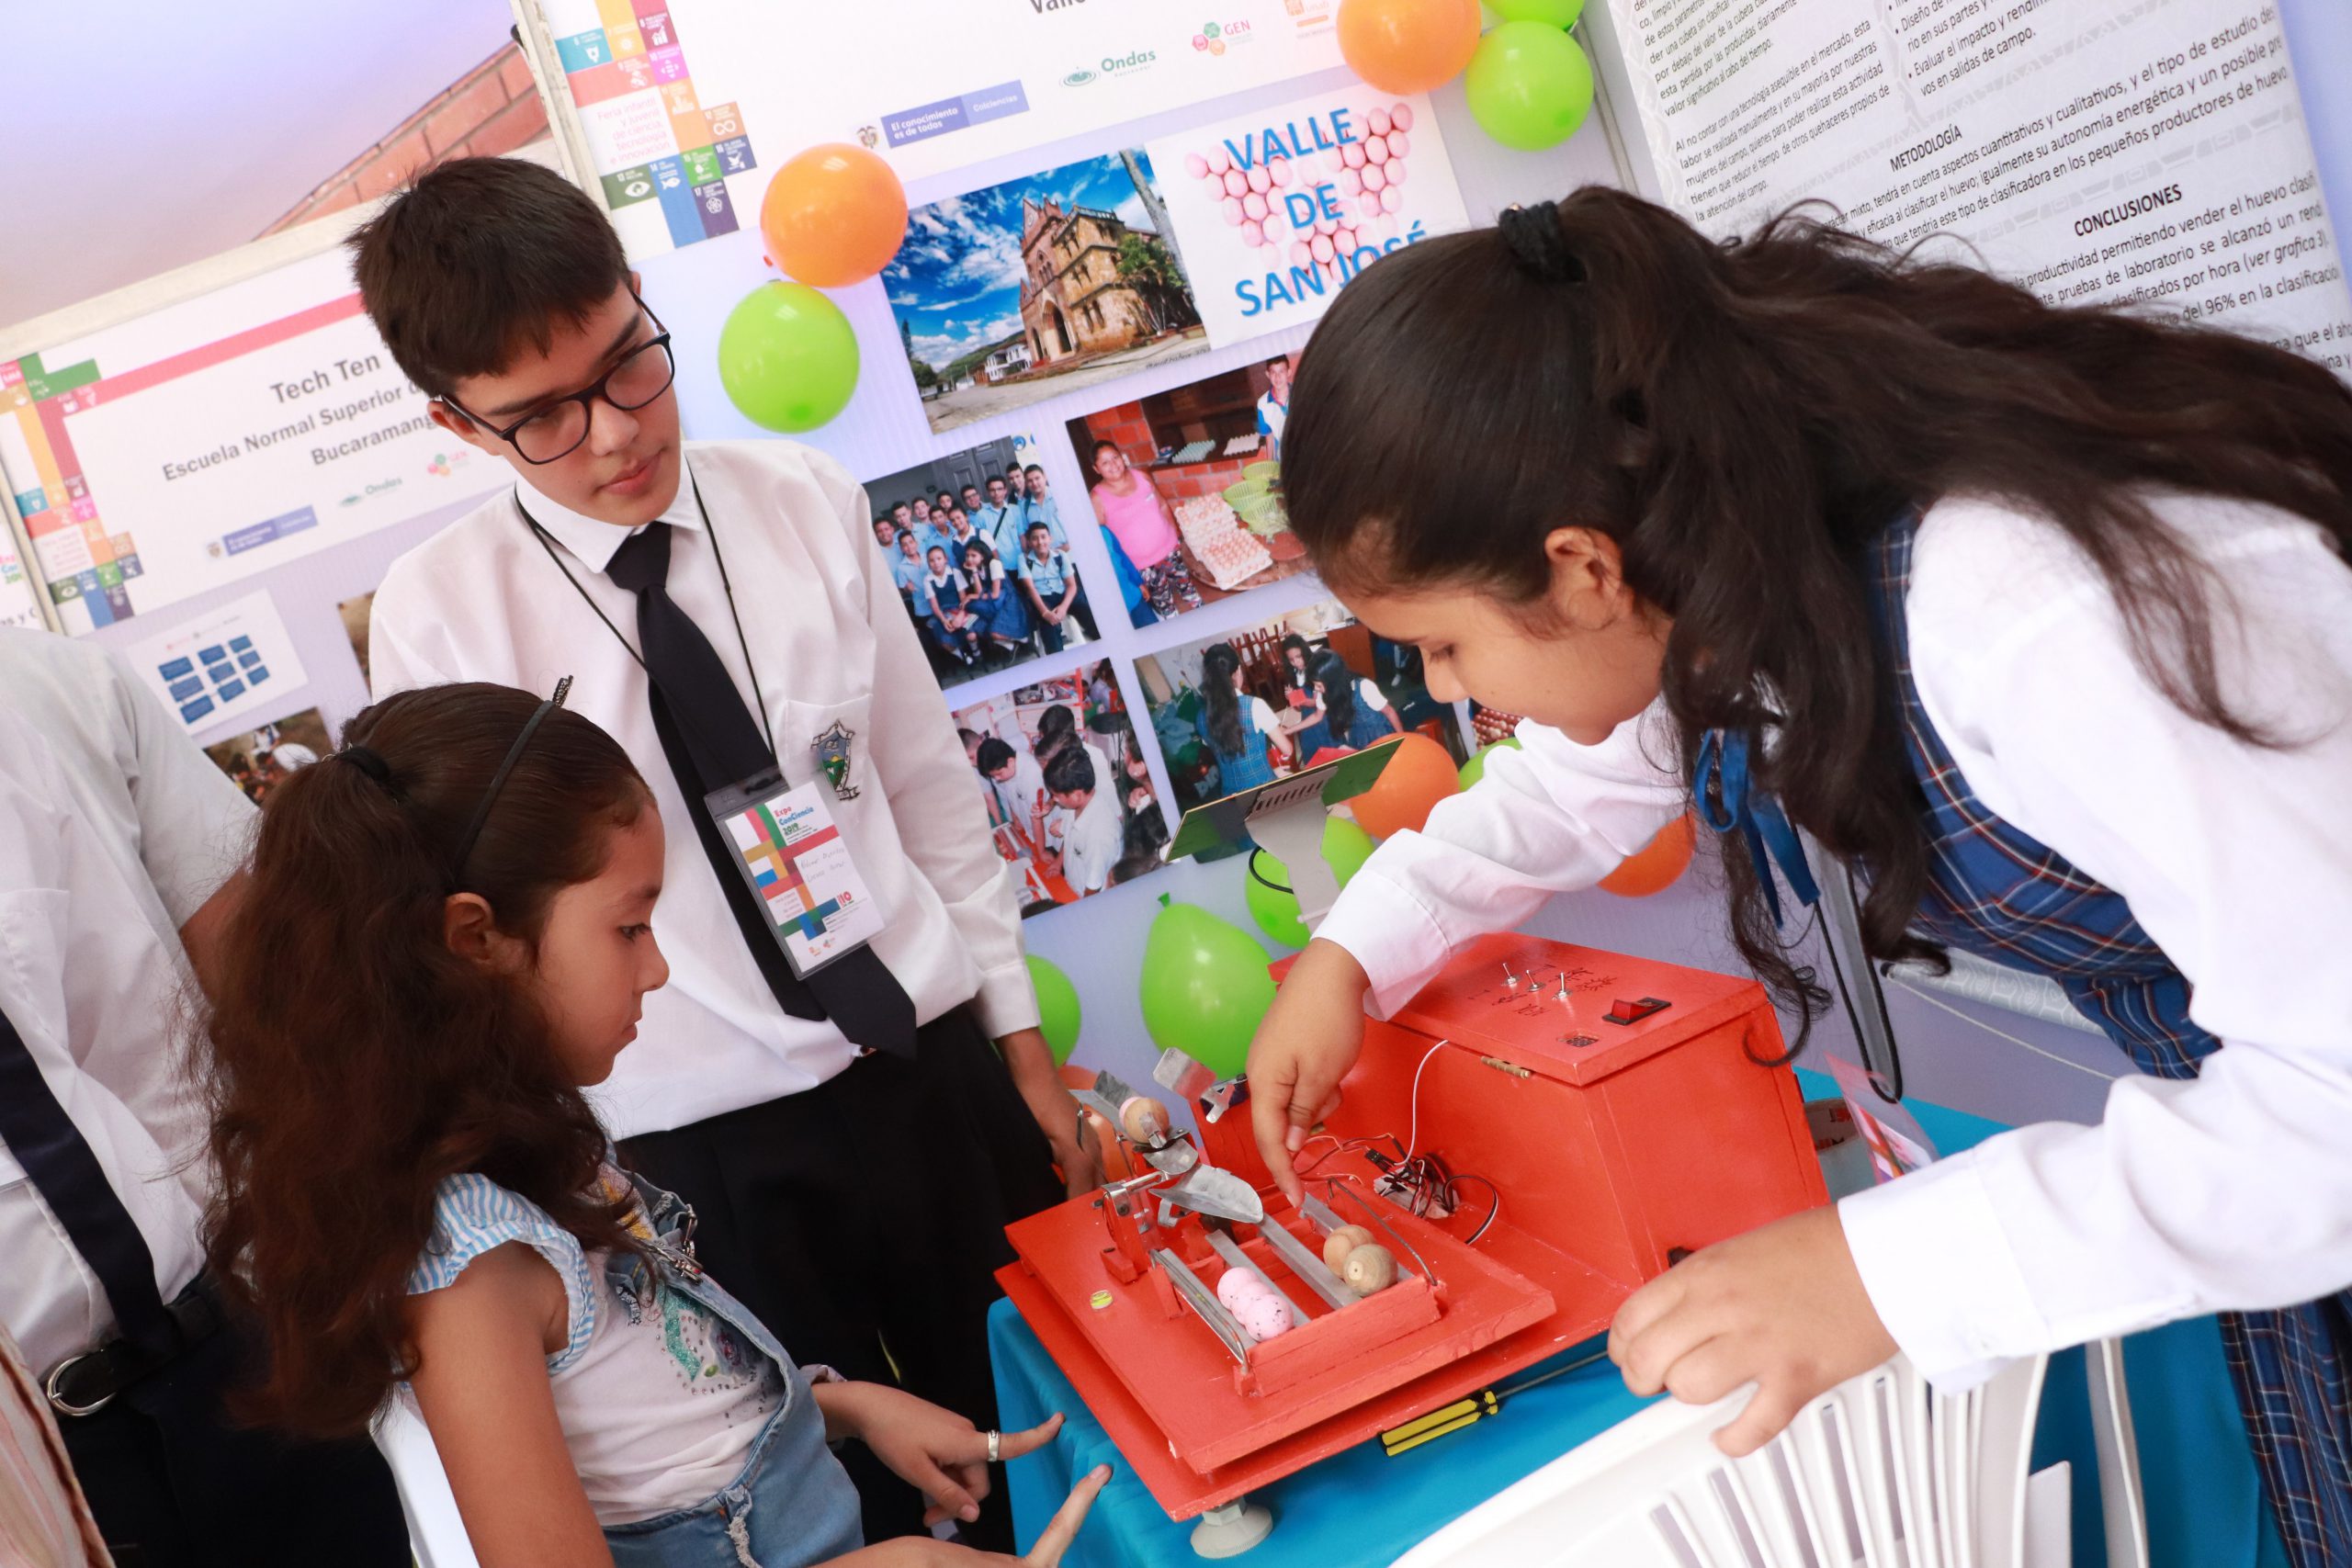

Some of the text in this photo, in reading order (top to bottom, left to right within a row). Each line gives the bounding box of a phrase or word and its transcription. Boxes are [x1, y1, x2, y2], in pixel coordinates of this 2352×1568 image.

[1225, 19, 1250, 35] GEN
[1639, 19, 1652, 29] co,
[1645, 21, 1674, 47] de estos
[1655, 67, 1669, 84] por
[1672, 53, 1692, 73] debajo
[1693, 44, 1702, 57] del
[1718, 25, 1725, 38] de
[1727, 18, 1733, 29] la
[1734, 2, 1754, 25] cubeta
[1901, 6, 1929, 32] Diseño
[1907, 2, 1980, 52] rio en sus partes
[1102, 51, 1156, 72] Ondas
[1650, 27, 1698, 64] der una cubeta
[1660, 84, 1678, 99] esta
[1680, 67, 1702, 89] perdida
[1703, 61, 1713, 75] por
[1715, 51, 1724, 63] las
[1724, 26, 1756, 57] producidas
[1914, 20, 1996, 76] Evaluar el impacto
[1920, 27, 2036, 96] vos en salidas de campo.
[1665, 51, 1749, 117] valor significativo al cabo del
[1676, 139, 1685, 152] Al
[1687, 135, 1697, 147] no
[1698, 122, 1717, 141] contar
[1718, 115, 1728, 129] con
[1730, 108, 1739, 121] una
[1770, 64, 1800, 94] asequible
[1801, 60, 1810, 73] en
[1811, 51, 1818, 65] el
[1854, 19, 1871, 38] esta
[1679, 40, 1877, 169] labor se realizada manualmente en su por nuestras
[1901, 182, 1911, 196] en
[1913, 168, 1940, 189] cuenta
[1941, 150, 1979, 177] aspectos
[1980, 118, 2044, 158] cuantitativos
[2056, 78, 2127, 122] cualitativos,
[2142, 62, 2154, 83] el
[2156, 51, 2185, 74] tipo
[2188, 41, 2207, 61] de
[2211, 16, 2257, 51] estudio
[890, 107, 959, 131] El conocimiento
[894, 130, 904, 140] es
[1224, 107, 1358, 172] VALLE
[1686, 59, 1883, 187] mujeres del quienes para poder realizar esta actividad
[1690, 83, 1890, 205] tienen que reducir el tiempo de quehaceres propios de
[1867, 213, 1894, 234] eficacia
[1895, 207, 1904, 221] al
[1904, 192, 1939, 218] clasificar
[1940, 187, 1948, 201] el
[1980, 150, 2034, 185] igualmente
[2036, 143, 2049, 159] su
[2051, 113, 2113, 152] autonomía
[2116, 83, 2185, 123] energética
[2199, 67, 2218, 86] un
[2221, 39, 2266, 81] posible
[1890, 123, 1962, 172] METODOLOGÍA
[1894, 231, 1908, 246] que
[1939, 211, 1958, 226] este
[1958, 201, 1975, 220] tipo
[1977, 195, 1989, 209] de
[1991, 169, 2052, 205] clasificadora
[2052, 163, 2067, 177] en
[2067, 155, 2086, 171] los
[2087, 128, 2149, 166] pequeños
[2152, 92, 2233, 140] productores
[2236, 81, 2254, 101] de
[1283, 183, 1344, 230] DE
[1695, 188, 1747, 222] la atención del
[2075, 184, 2183, 238] CONCLUSIONES
[2027, 186, 2287, 288] productividad permitiendo vender el huevo
[2058, 276, 2101, 306] pruebas
[2106, 270, 2120, 286] de
[2124, 246, 2194, 279] laboratorio
[2199, 241, 2216, 255] se
[2221, 217, 2272, 248] alcanzó
[2278, 213, 2294, 230] un
[1235, 260, 1326, 316] SAN
[2183, 271, 2205, 291] por
[2208, 260, 2241, 280] hora
[2243, 251, 2270, 273] (ver
[2205, 282, 2273, 316] 96% en la
[2294, 330, 2320, 351] que
[2324, 322, 2334, 343] el
[270, 354, 382, 404] Tech Ten
[162, 383, 405, 481] Escuela Normal Superior
[310, 414, 437, 466] Bucaramang
[774, 807, 792, 818] Expo
[779, 807, 815, 826] ConCiencia
